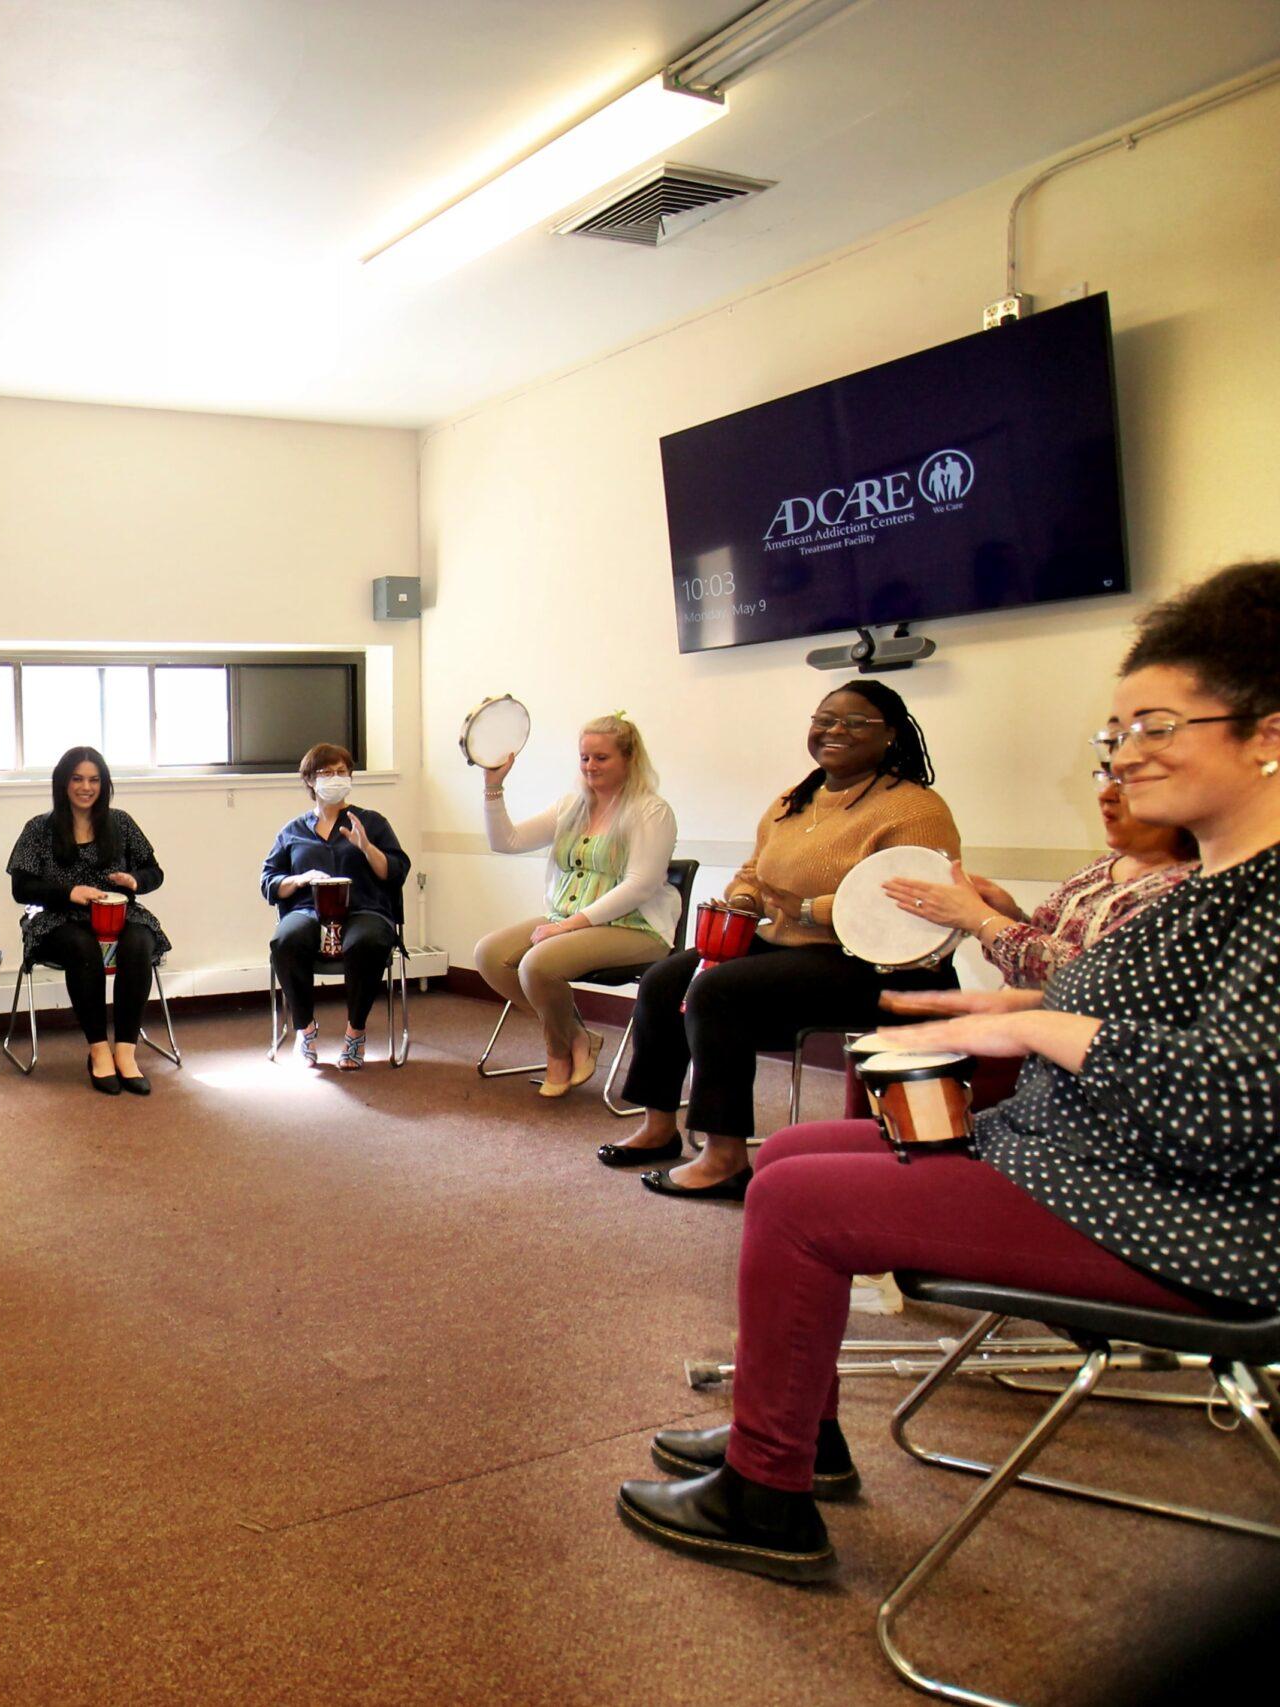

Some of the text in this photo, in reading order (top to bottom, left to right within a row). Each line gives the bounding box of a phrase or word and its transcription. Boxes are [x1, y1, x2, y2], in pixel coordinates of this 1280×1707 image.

[764, 511, 915, 552] American Addiction Centers
[798, 533, 876, 557] Treatment Facility
[682, 571, 736, 602] 10:03
[732, 603, 757, 617] May
[758, 599, 767, 612] 9
